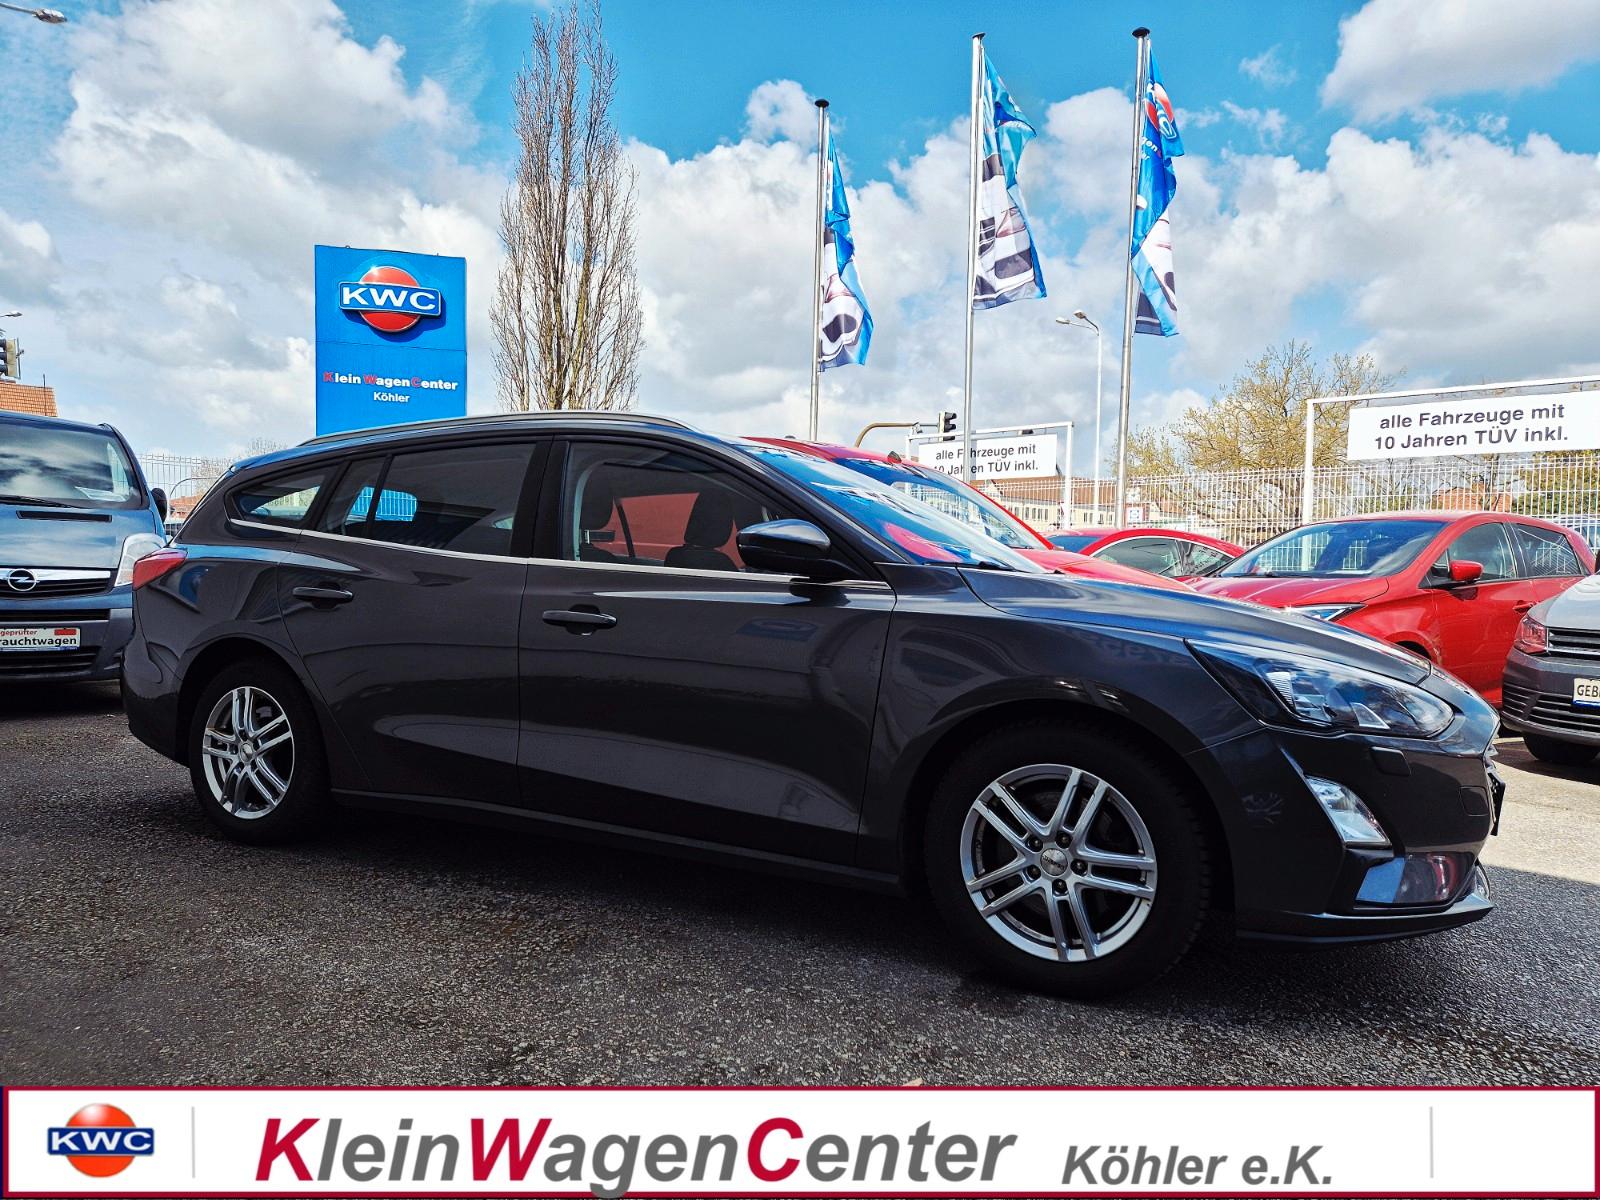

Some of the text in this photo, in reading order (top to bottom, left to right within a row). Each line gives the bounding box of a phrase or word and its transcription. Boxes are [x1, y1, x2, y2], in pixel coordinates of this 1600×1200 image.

[342, 287, 436, 310] KWC
[323, 372, 361, 384] Klein
[373, 391, 410, 403] Köhler
[1379, 403, 1565, 430] alle Fahrzeuge mit
[1375, 426, 1568, 450] 10 Jahren TÜV inkl.
[936, 443, 1036, 460] alle Fhrzeuge mit
[948, 463, 984, 475] Jahen
[988, 459, 1011, 472] TÜV
[1014, 460, 1039, 471] inkl.
[0, 636, 77, 647] auchtwagen
